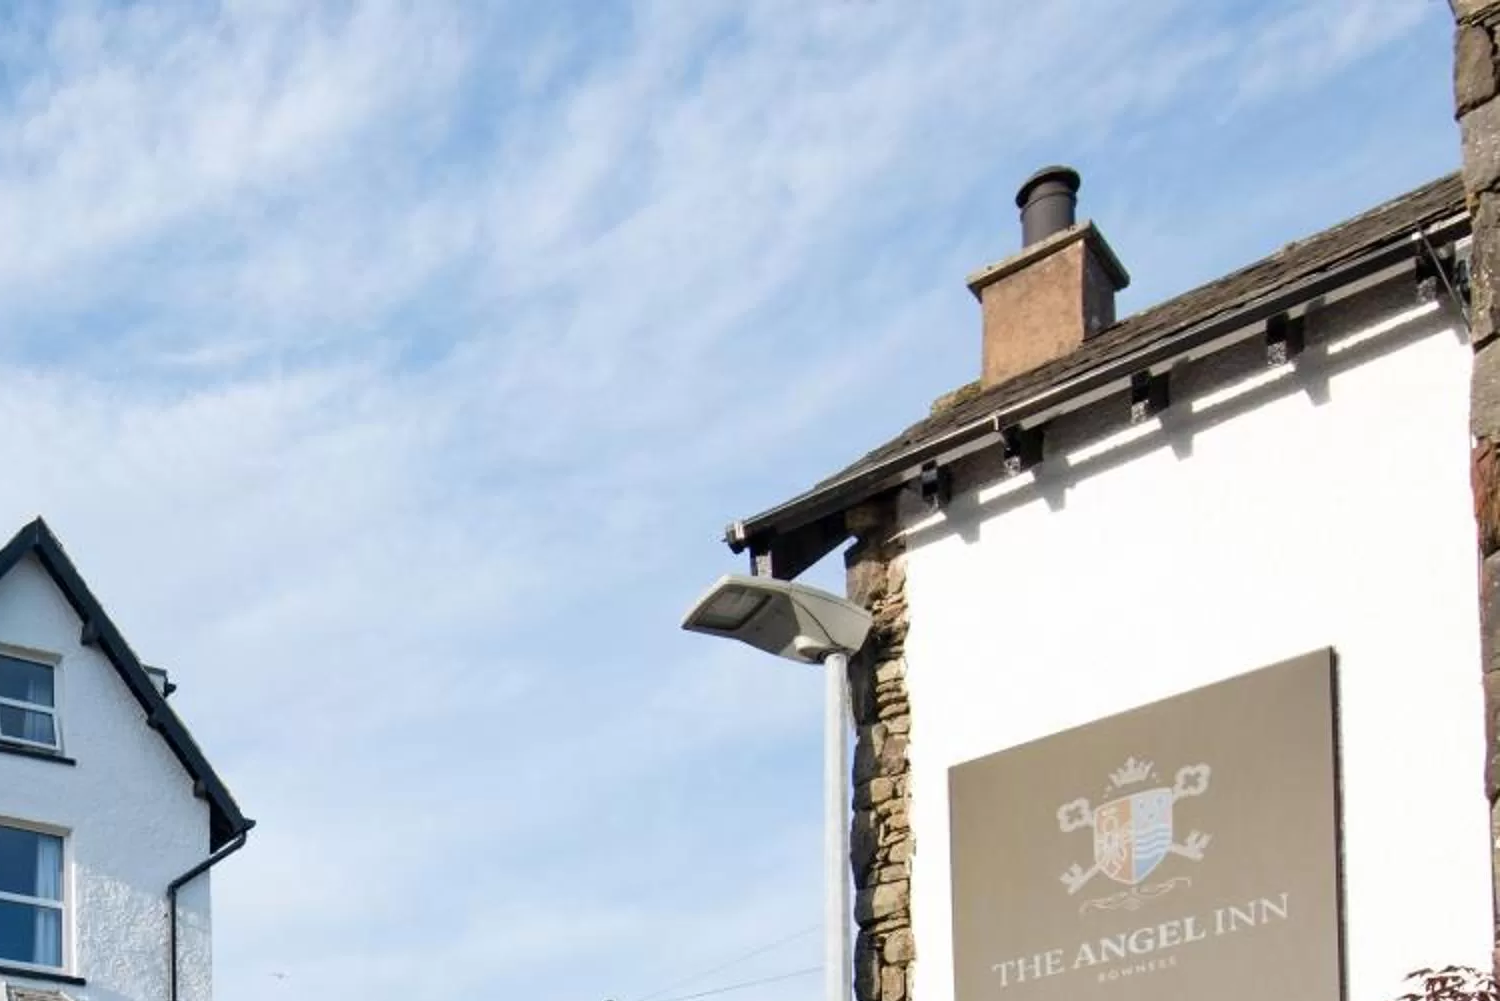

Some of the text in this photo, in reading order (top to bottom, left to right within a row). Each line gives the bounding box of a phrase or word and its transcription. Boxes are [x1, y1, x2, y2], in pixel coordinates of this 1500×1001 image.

[991, 891, 1288, 987] THE ANGEL INN
